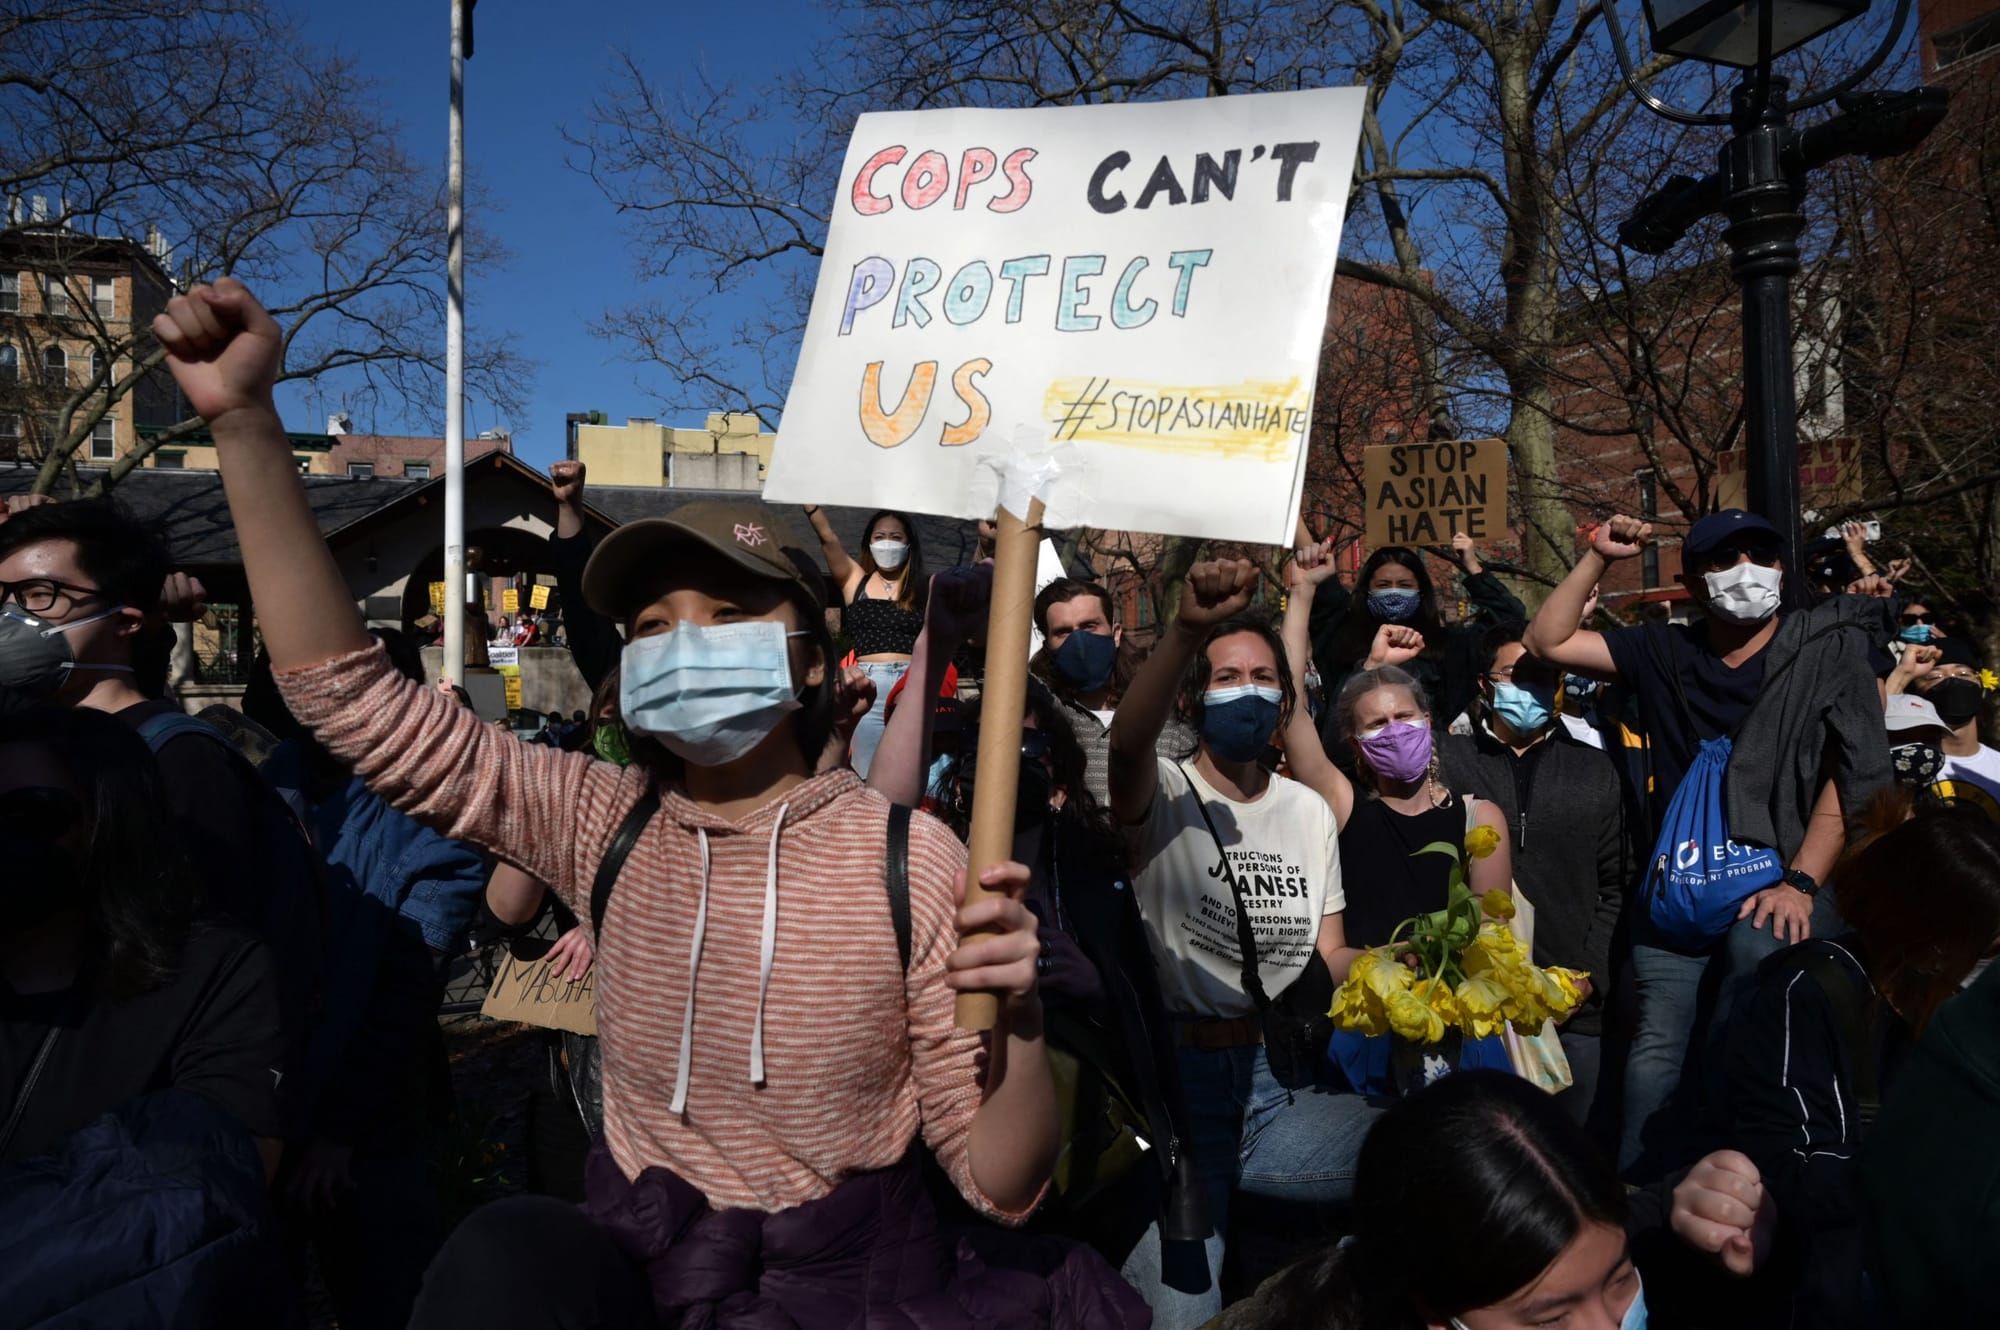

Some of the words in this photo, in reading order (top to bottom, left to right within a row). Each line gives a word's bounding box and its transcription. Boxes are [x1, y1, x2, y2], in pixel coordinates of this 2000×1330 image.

[852, 145, 1039, 216] COPS
[1086, 141, 1320, 214] CAN'T
[838, 249, 1213, 337] PROTECT
[859, 357, 993, 449] US
[1052, 376, 1307, 441] #STOPASIANHATE
[1389, 442, 1477, 477] STOP
[1376, 474, 1488, 509] ASIAN
[1388, 507, 1486, 543] HATE
[1226, 851, 1283, 862] TRUCTIONS
[1238, 863, 1282, 873] PERSONS
[1287, 866, 1300, 874] OF
[1727, 860, 1773, 877] PROGRAM
[1208, 859, 1308, 899] JANESE
[1201, 894, 1222, 909] AND
[1225, 905, 1236, 917] TO
[1249, 916, 1292, 925] PERSONS
[1294, 917, 1311, 925] WHO
[1242, 900, 1283, 908] CESTRY
[1190, 939, 1215, 952] SPEAK
[1216, 950, 1233, 960] OUT
